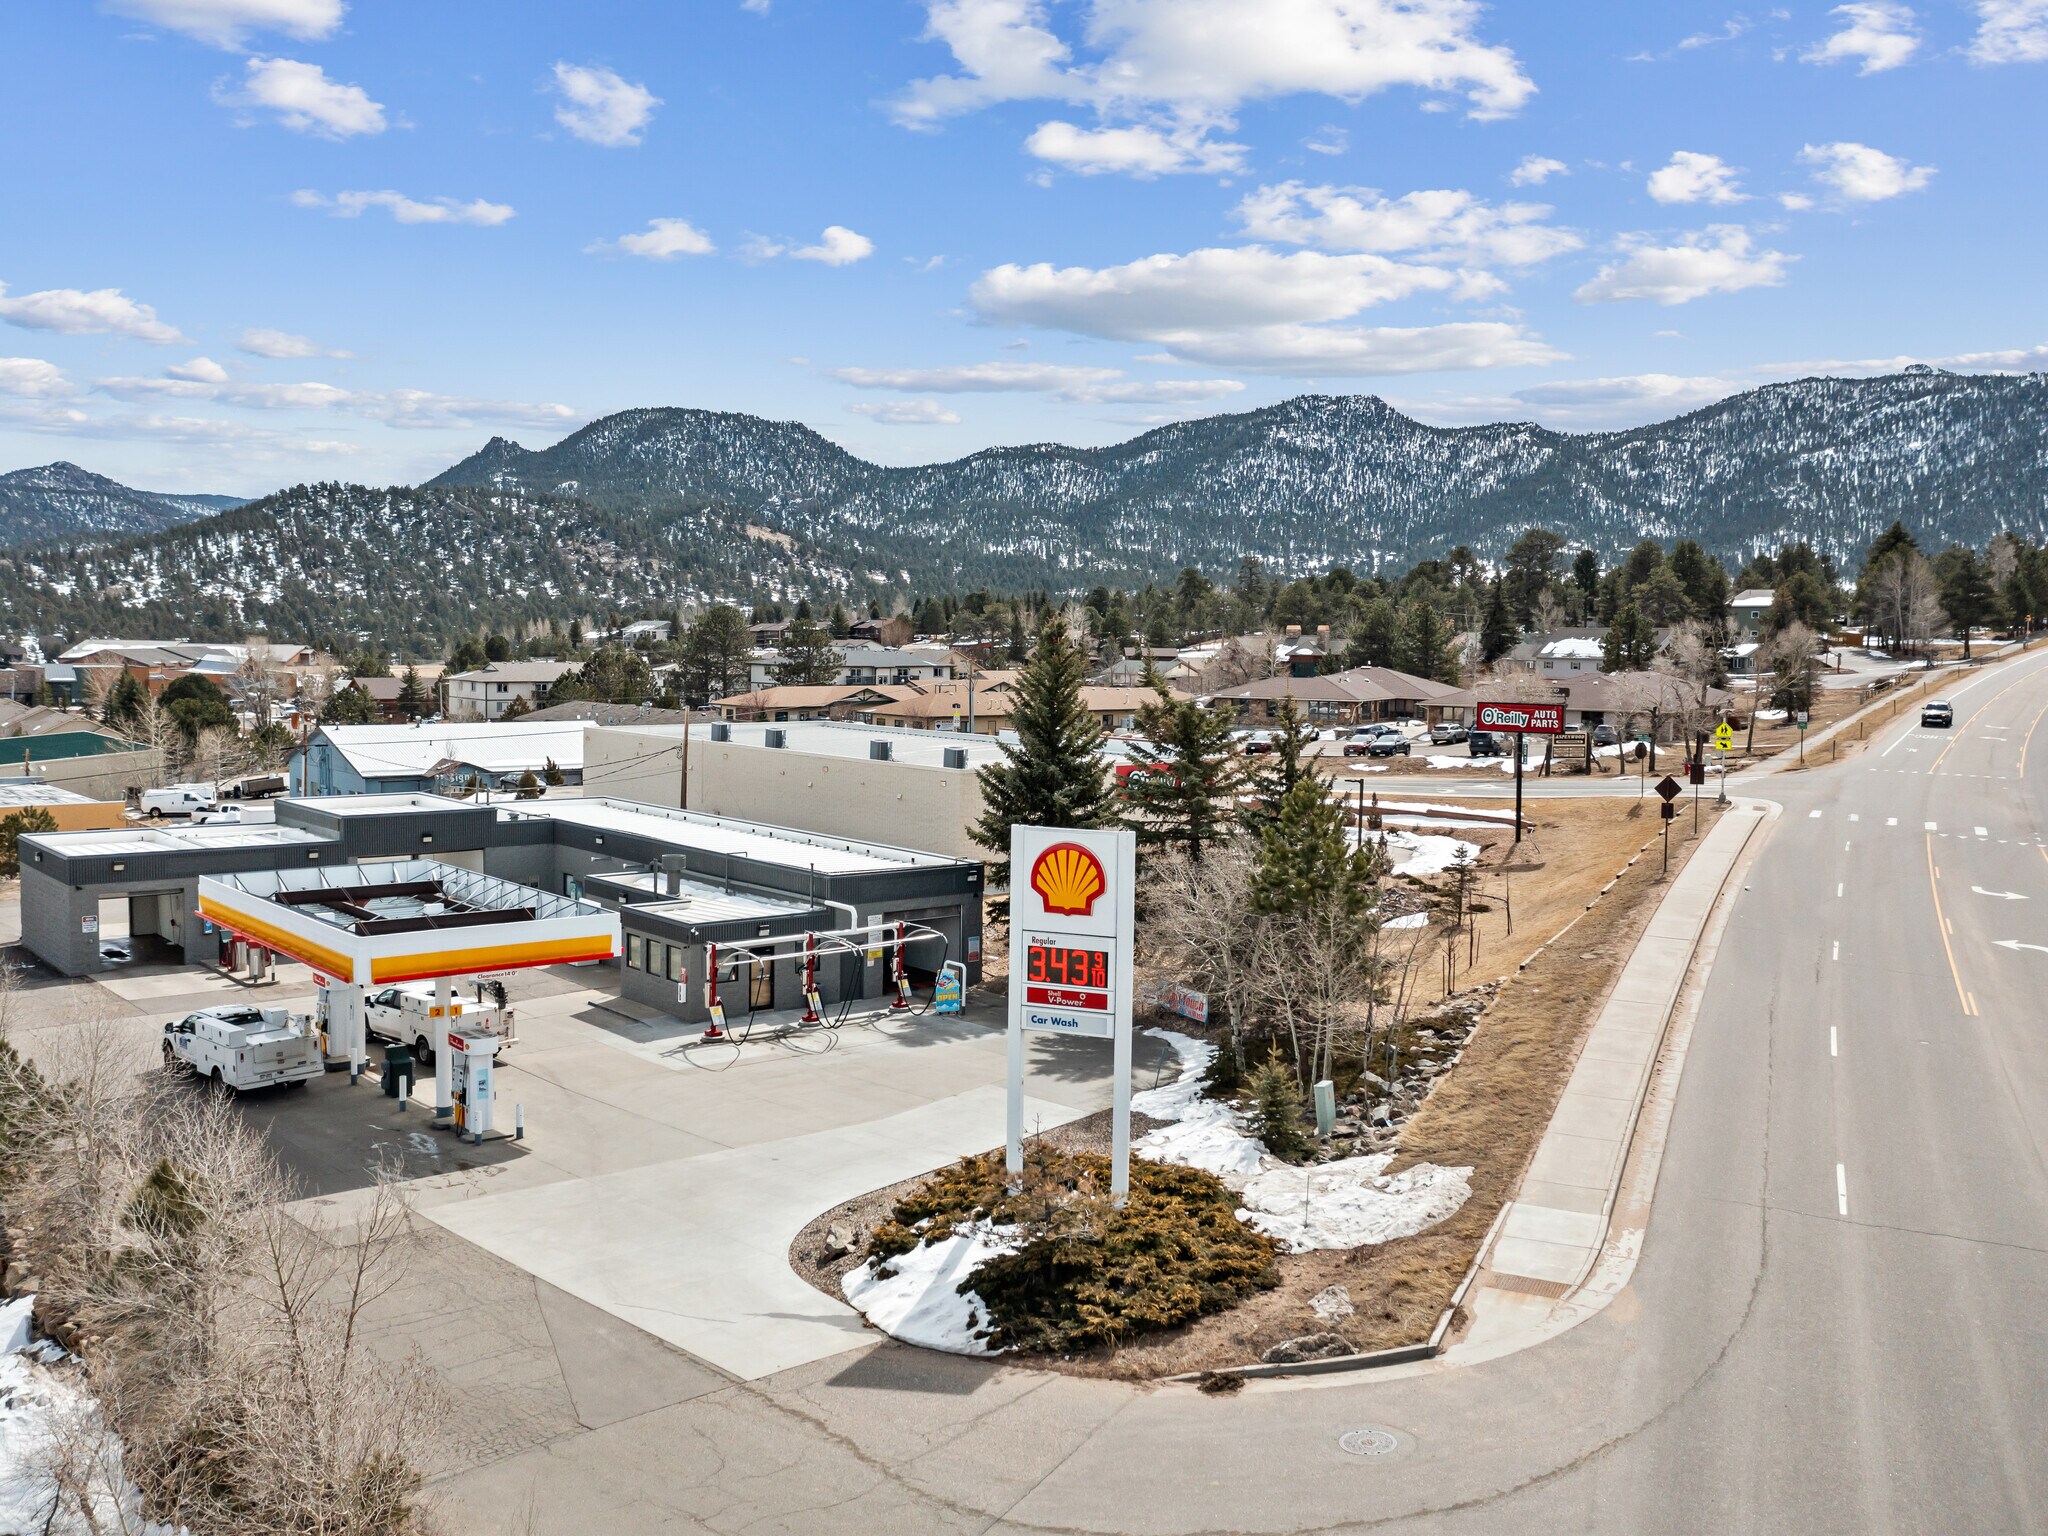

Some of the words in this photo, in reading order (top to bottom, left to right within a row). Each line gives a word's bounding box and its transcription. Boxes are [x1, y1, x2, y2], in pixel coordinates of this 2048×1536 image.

[1482, 708, 1529, 727] O'Reilly
[1534, 710, 1557, 719] AUTO
[1531, 719, 1559, 728] PARTS
[1031, 936, 1056, 946] Regular
[1029, 946, 1088, 986] 3.43
[937, 993, 958, 1002] OPEN
[1048, 996, 1083, 1006] V-Power
[435, 1008, 441, 1016] 2
[1031, 1015, 1048, 1024] Car
[1051, 1017, 1078, 1028] Wash
